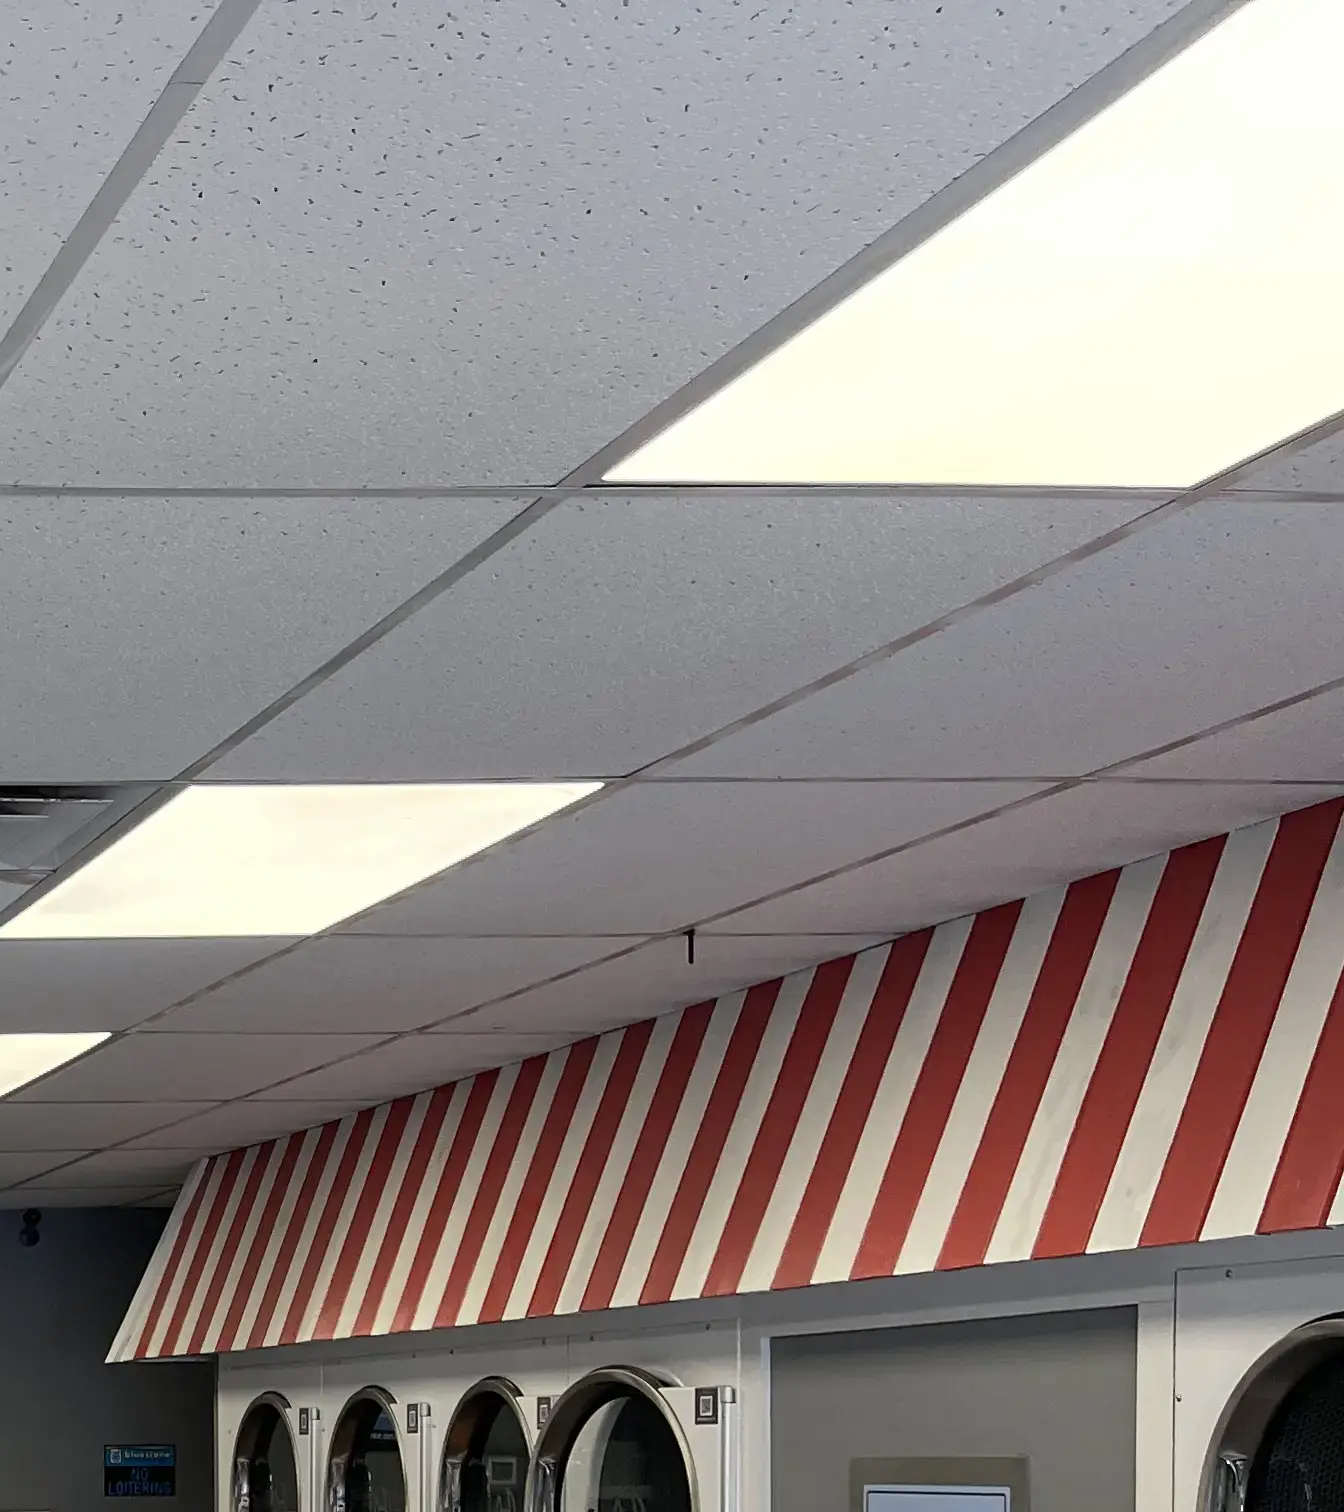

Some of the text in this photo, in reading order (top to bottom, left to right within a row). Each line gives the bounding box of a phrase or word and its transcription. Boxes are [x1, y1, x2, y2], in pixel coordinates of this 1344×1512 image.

[124, 1450, 171, 1459] bluestone
[131, 1468, 149, 1482] NO
[108, 1481, 172, 1495] LOITERING
